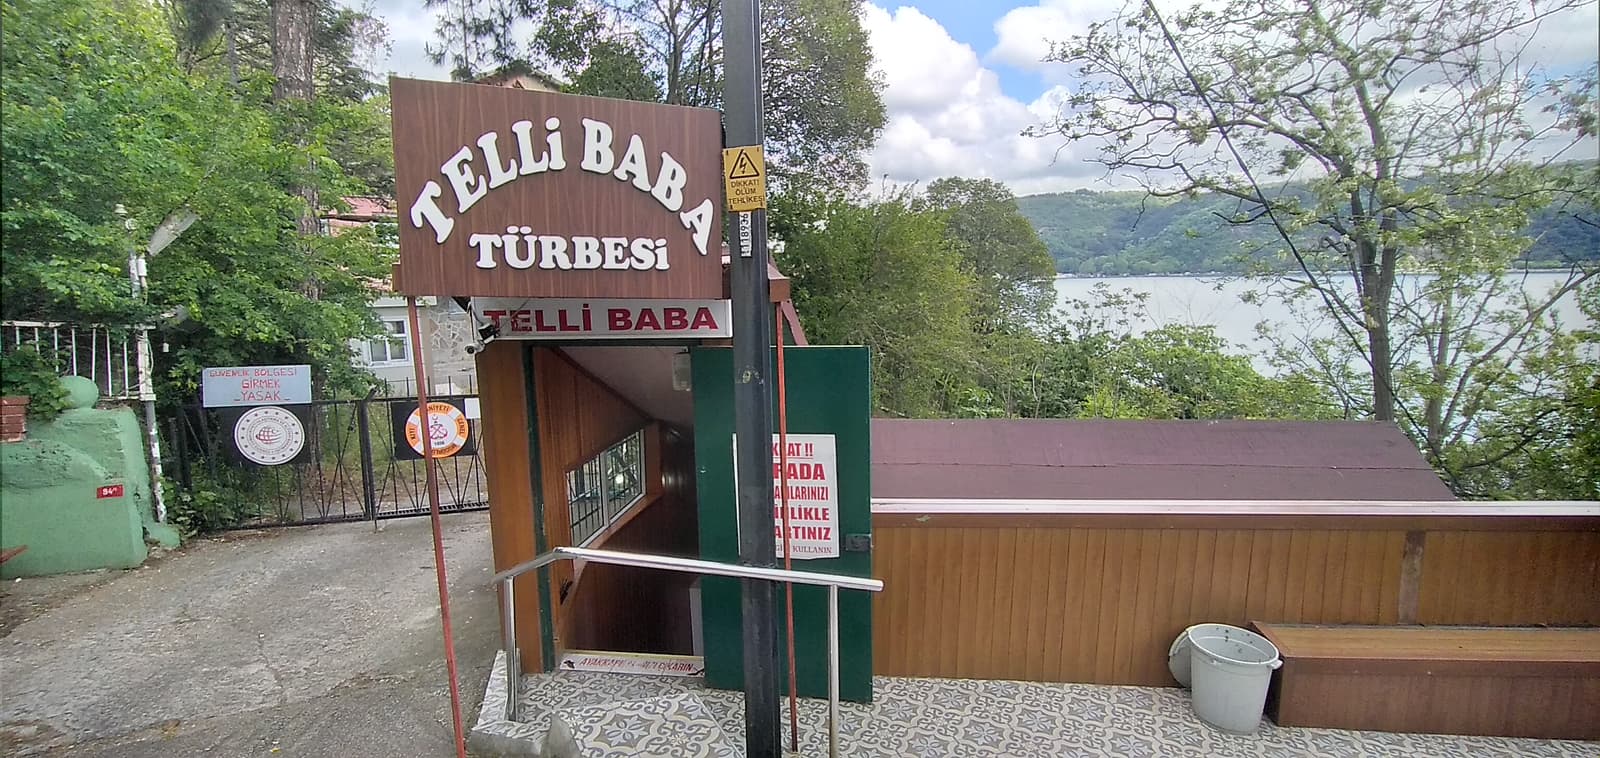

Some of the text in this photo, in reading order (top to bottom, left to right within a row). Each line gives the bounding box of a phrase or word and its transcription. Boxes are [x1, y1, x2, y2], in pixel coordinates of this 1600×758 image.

[580, 117, 714, 256] BABA
[483, 303, 719, 332] TELLİ BABA
[241, 390, 281, 401] YASAK
